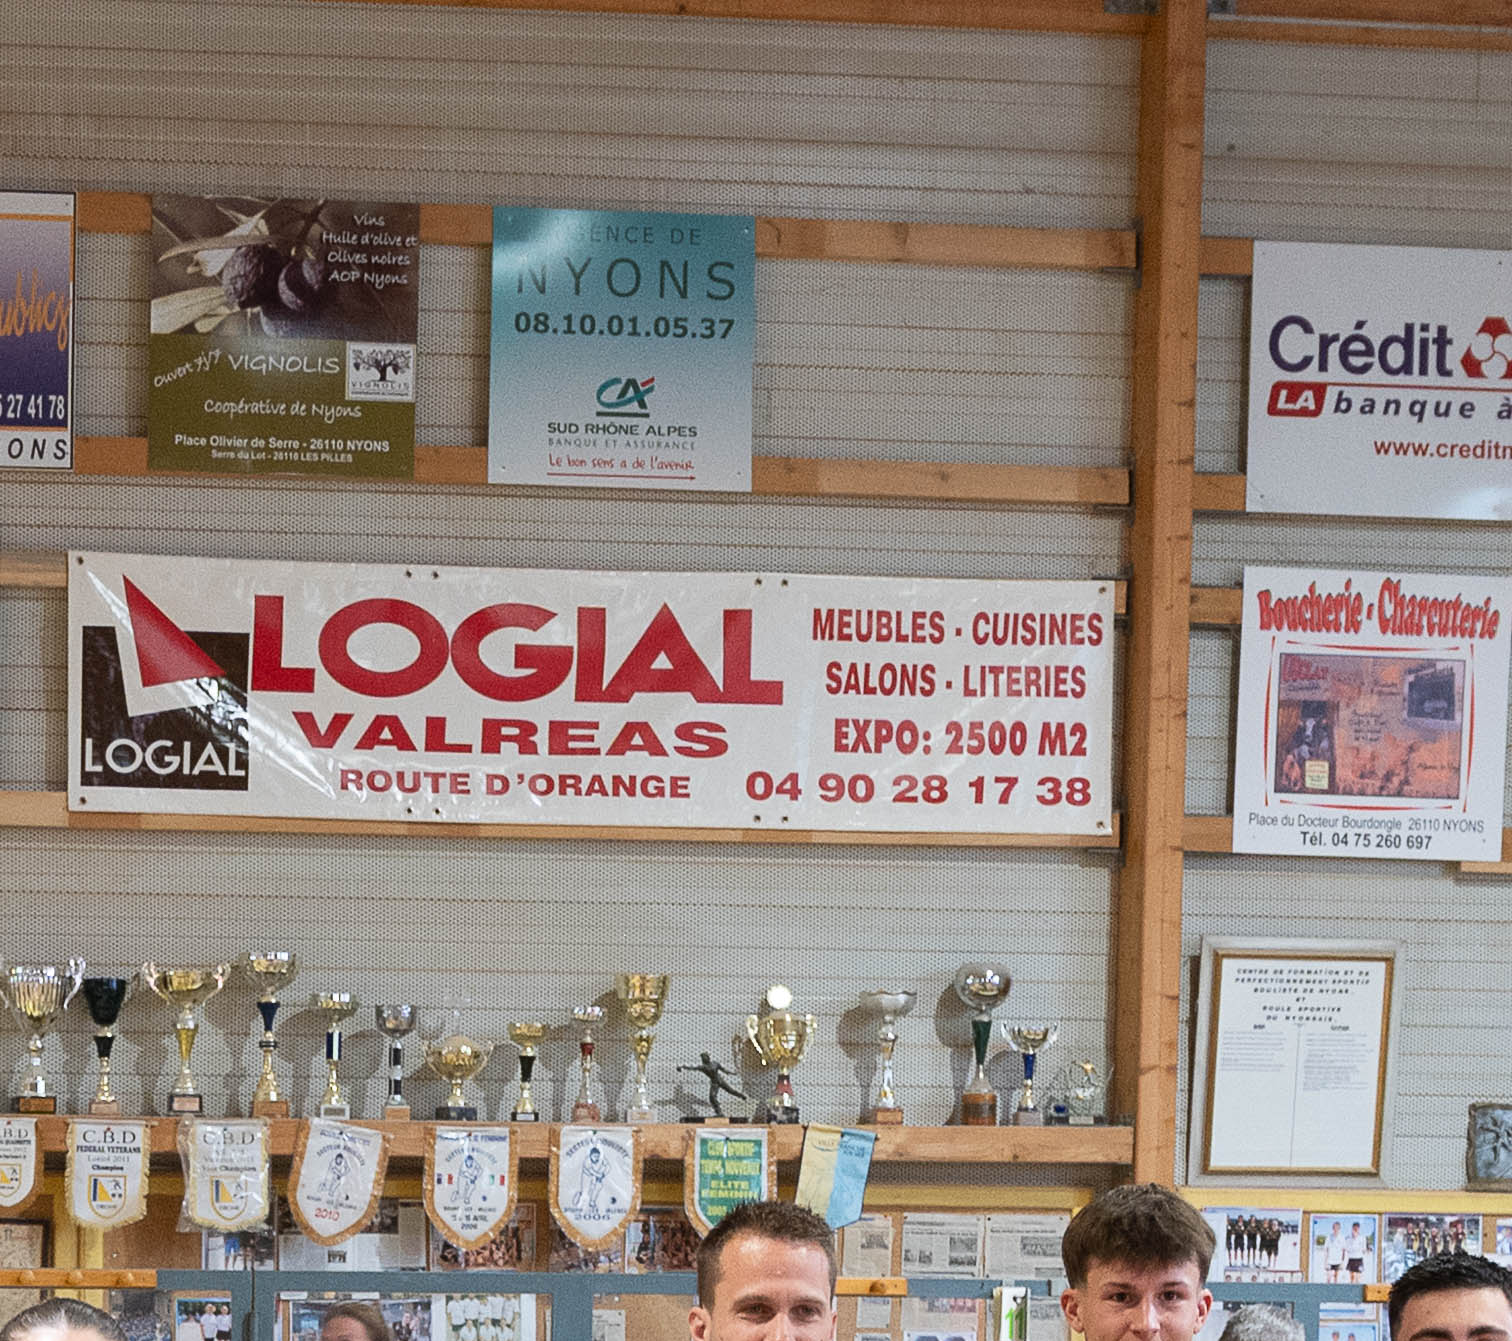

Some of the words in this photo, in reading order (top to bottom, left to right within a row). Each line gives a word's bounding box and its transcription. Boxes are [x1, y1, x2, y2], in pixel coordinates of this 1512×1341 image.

[353, 214, 386, 226] Vins
[670, 228, 701, 245] DE
[329, 270, 360, 282] AOP
[363, 271, 408, 289] Nyons
[518, 257, 736, 300] NYONS
[514, 312, 735, 339] 08.10.01.05.37
[1268, 314, 1454, 378] Crédit
[228, 354, 341, 375] VIGNOLIS
[7, 394, 22, 418] 27
[28, 394, 43, 418] 41
[49, 395, 65, 419] 78
[204, 399, 286, 418] Coopérative
[290, 403, 306, 416] de
[311, 404, 362, 423] Nyons
[547, 422, 580, 434] SUD
[584, 420, 639, 435] RHÔNE
[645, 424, 698, 437] ALPES
[1257, 580, 1362, 634] Boucherie
[1377, 578, 1500, 641] Charcuterie
[813, 608, 945, 644] MEUBLES
[972, 612, 1104, 647] CUISINES
[250, 593, 784, 705] LOGIAL
[825, 661, 936, 697] SALONS
[963, 665, 1086, 699] LITERIES
[291, 711, 730, 760] VALREAS
[834, 718, 932, 756] EXPO:
[945, 720, 1027, 756] 2500
[1038, 721, 1087, 757] M2
[81, 737, 248, 779] LOGIAL
[745, 771, 802, 801] 04
[818, 772, 875, 803] 90
[892, 774, 948, 804] 28
[968, 776, 1019, 805] 17
[1036, 777, 1092, 806] 38
[1300, 832, 1326, 846] Tél.
[1332, 832, 1348, 847] 04
[1354, 833, 1371, 847] 75
[1376, 835, 1401, 849] 260
[1406, 835, 1432, 849] 697
[82, 1131, 135, 1144] C.B.D
